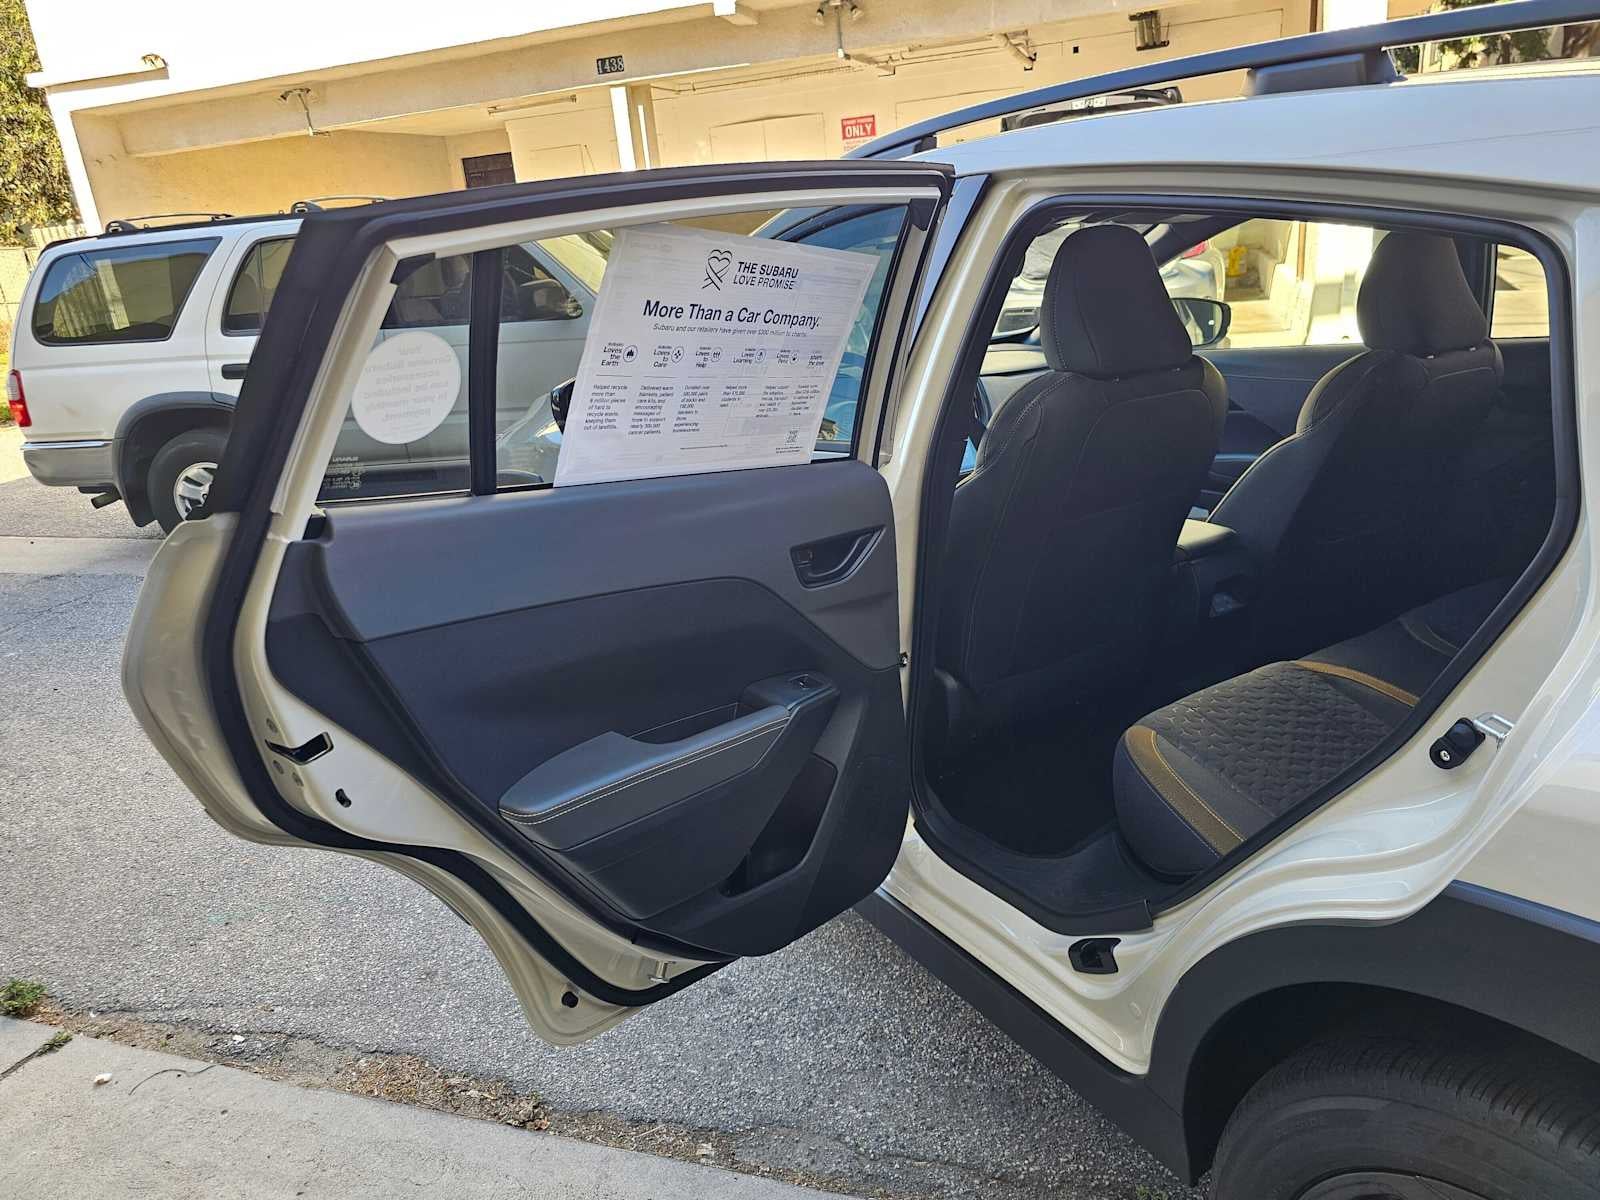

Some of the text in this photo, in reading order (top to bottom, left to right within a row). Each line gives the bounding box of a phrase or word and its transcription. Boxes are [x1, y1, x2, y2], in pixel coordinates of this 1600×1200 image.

[597, 56, 624, 74] 1438
[845, 123, 873, 138] ONLY
[738, 261, 799, 279] THE SUBARU
[733, 274, 795, 290] LOVE PROMISE
[643, 300, 820, 330] More Than a Car Company.
[653, 323, 675, 332] Subaru
[603, 346, 623, 354] Loves
[601, 359, 619, 367] Earth
